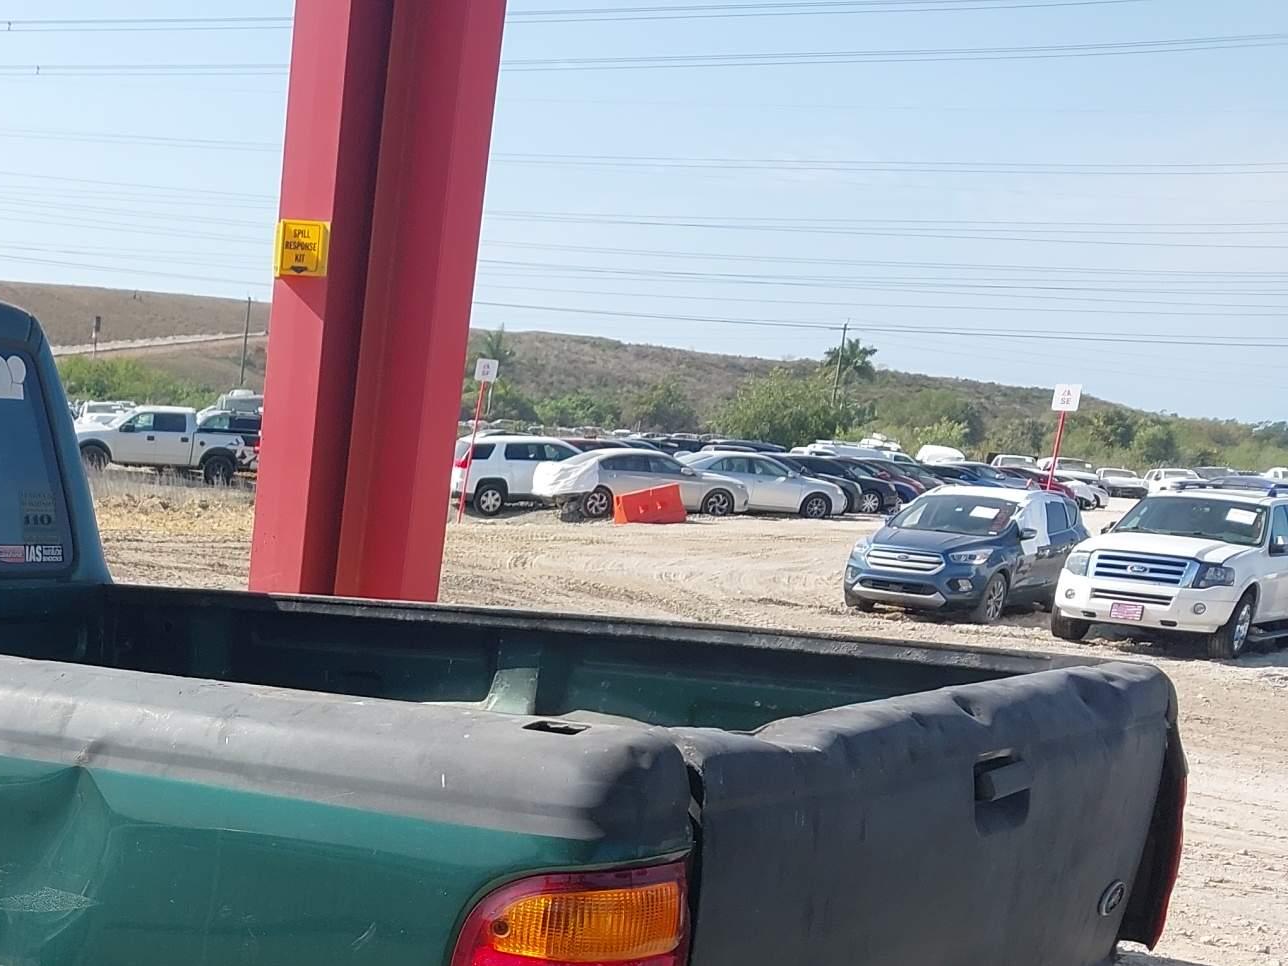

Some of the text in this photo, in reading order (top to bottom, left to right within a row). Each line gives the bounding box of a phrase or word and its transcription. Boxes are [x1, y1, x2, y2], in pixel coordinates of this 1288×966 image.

[293, 229, 310, 239] SPILL
[285, 241, 317, 251] RESPONSE
[294, 254, 305, 263] KIT
